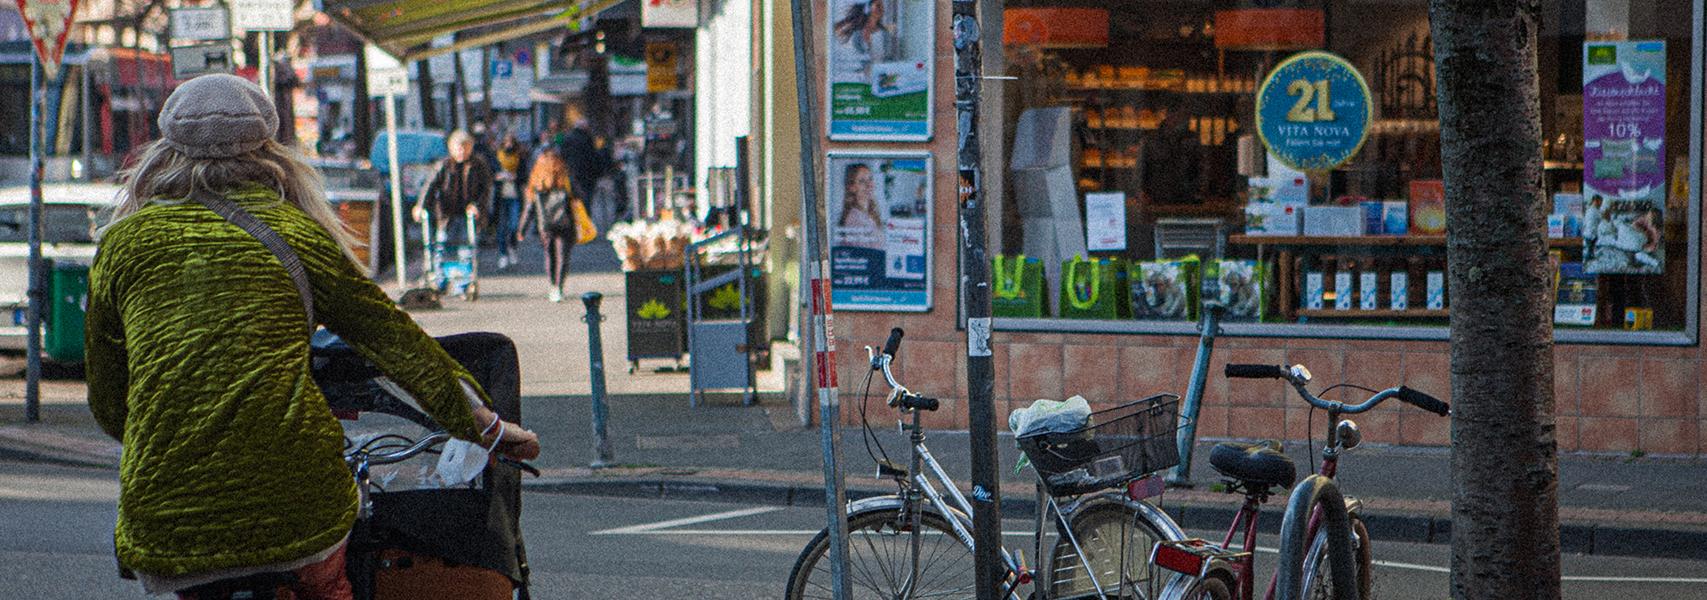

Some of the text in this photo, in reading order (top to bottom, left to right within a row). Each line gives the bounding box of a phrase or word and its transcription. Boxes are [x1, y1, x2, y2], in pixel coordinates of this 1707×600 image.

[1287, 79, 1335, 122] 21
[1278, 125, 1350, 137] VITA NOVA
[1608, 122, 1641, 137] 10%
